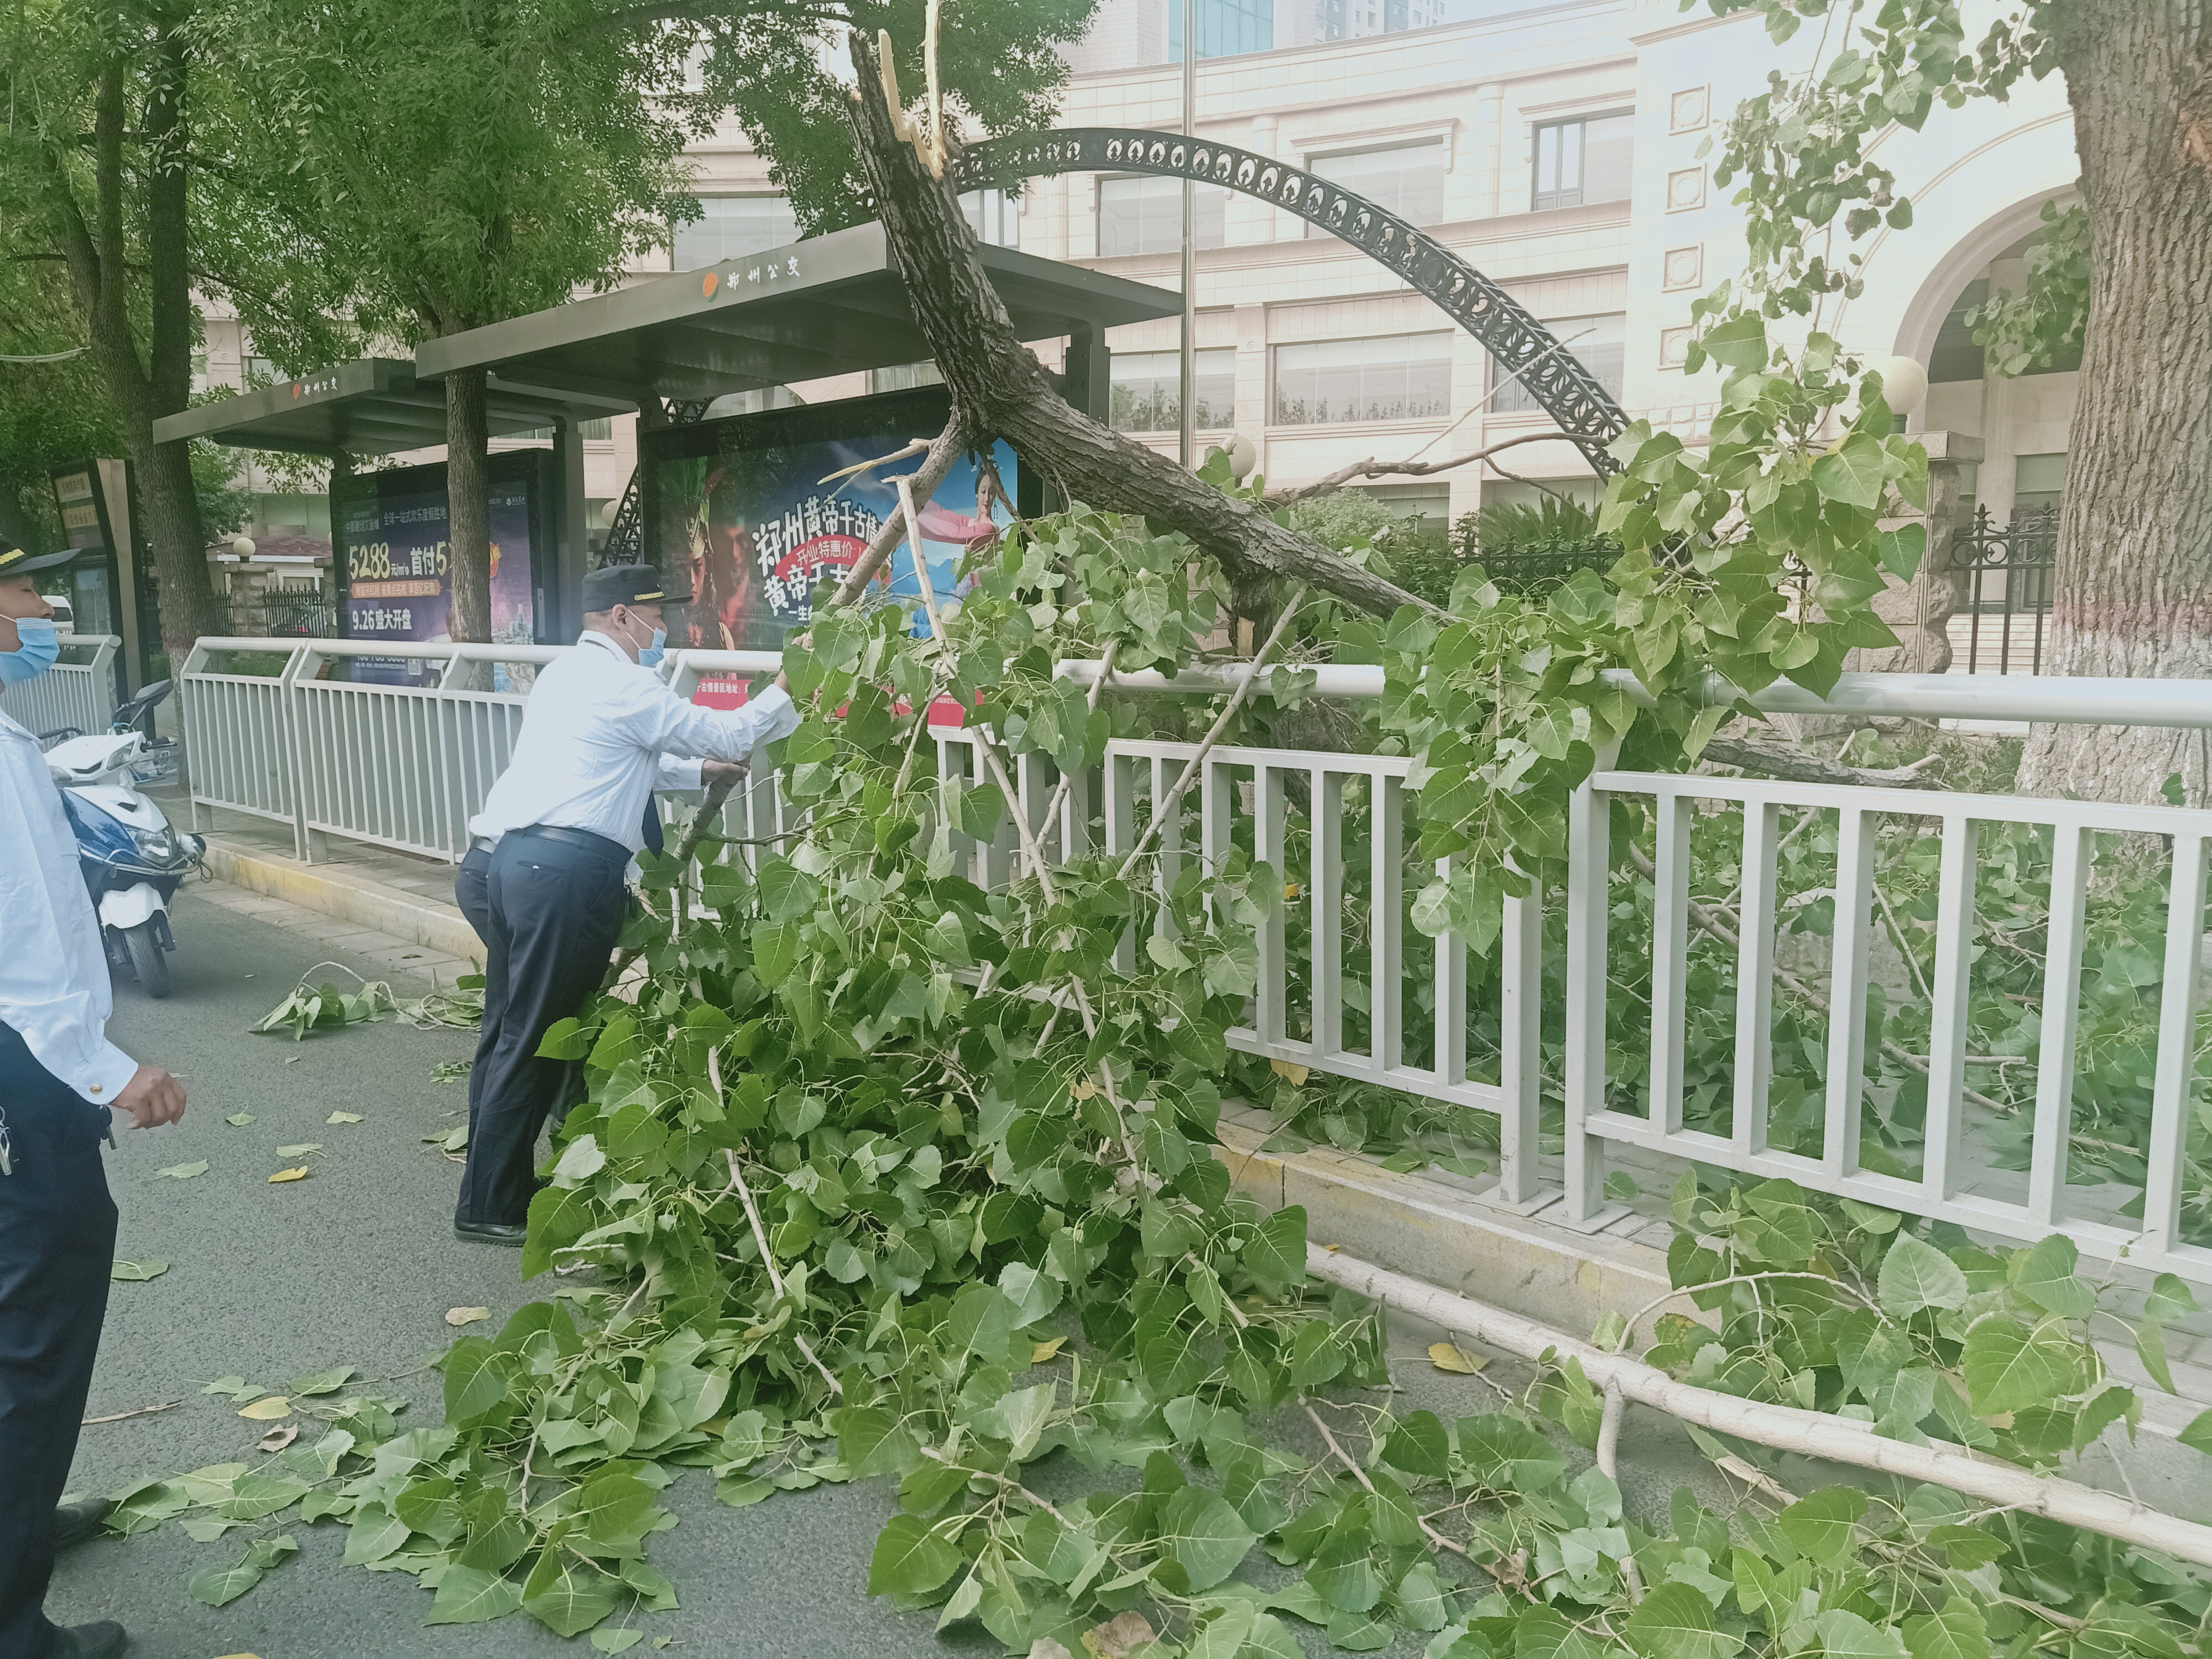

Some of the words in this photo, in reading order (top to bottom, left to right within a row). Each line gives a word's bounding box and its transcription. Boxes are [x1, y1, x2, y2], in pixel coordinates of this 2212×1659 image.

[727, 256, 800, 291] 郑州公交
[752, 494, 893, 577] 郑州黄帝千古情
[410, 541, 451, 576] 首付5
